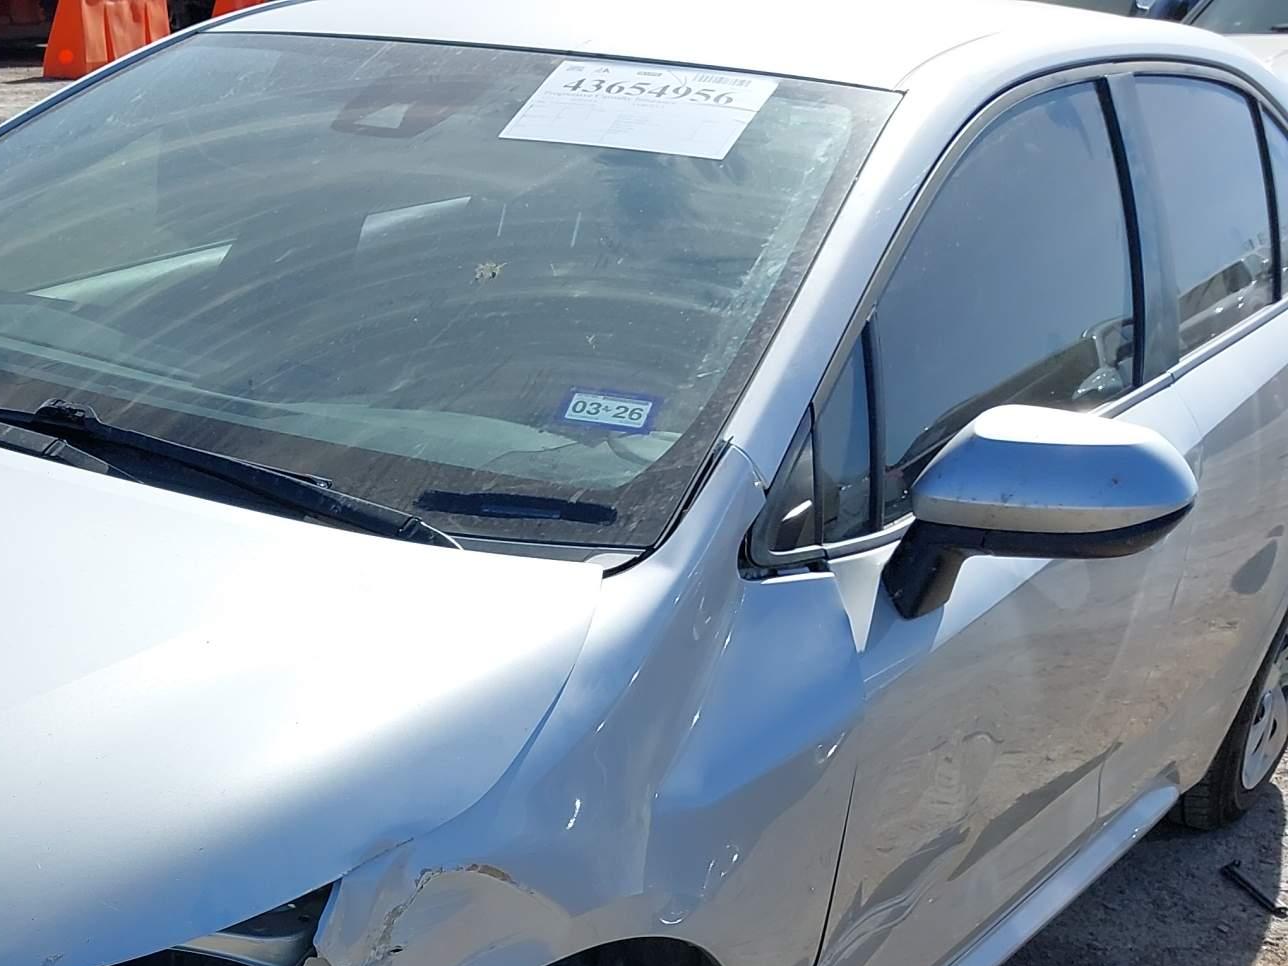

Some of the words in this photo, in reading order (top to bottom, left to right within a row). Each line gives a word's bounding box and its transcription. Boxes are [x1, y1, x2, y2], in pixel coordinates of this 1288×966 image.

[562, 77, 736, 106] 43654956
[571, 400, 602, 416] 03
[611, 405, 644, 421] 26
